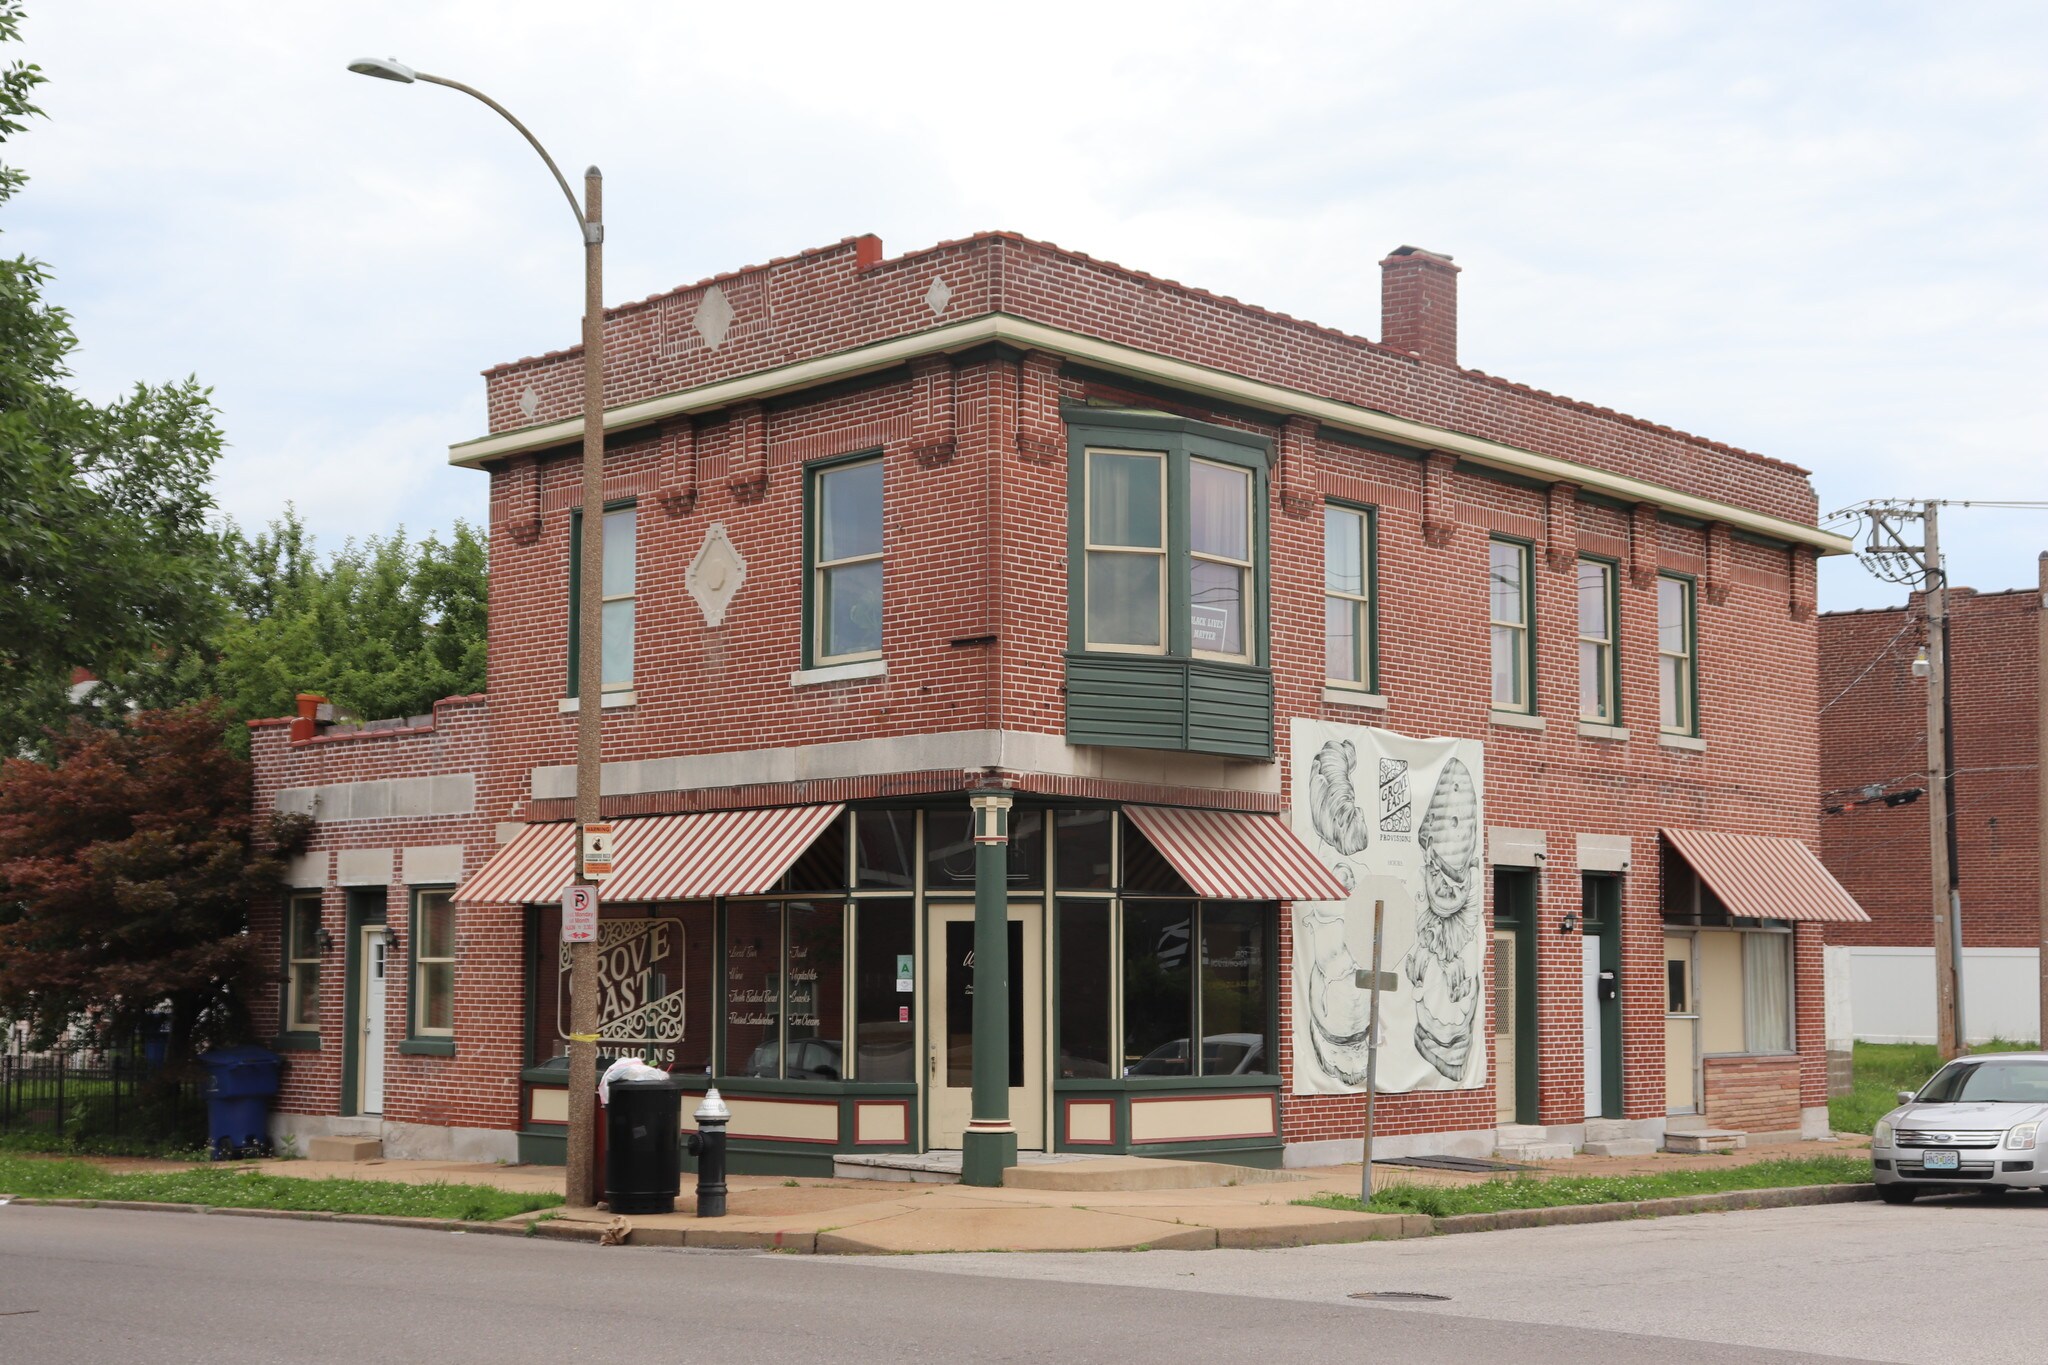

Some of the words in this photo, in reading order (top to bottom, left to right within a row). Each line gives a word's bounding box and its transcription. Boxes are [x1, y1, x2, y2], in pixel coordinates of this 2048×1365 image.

[1207, 618, 1224, 629] LIVES
[1194, 629, 1217, 641] MATTER
[1381, 774, 1408, 801] GROVE
[1387, 789, 1406, 812] EAST
[1380, 834, 1411, 842] PROVISIONS
[569, 923, 670, 996] ROVE
[902, 964, 909, 972] A
[597, 967, 652, 1027] AST
[564, 1045, 676, 1062] PVISIONS
